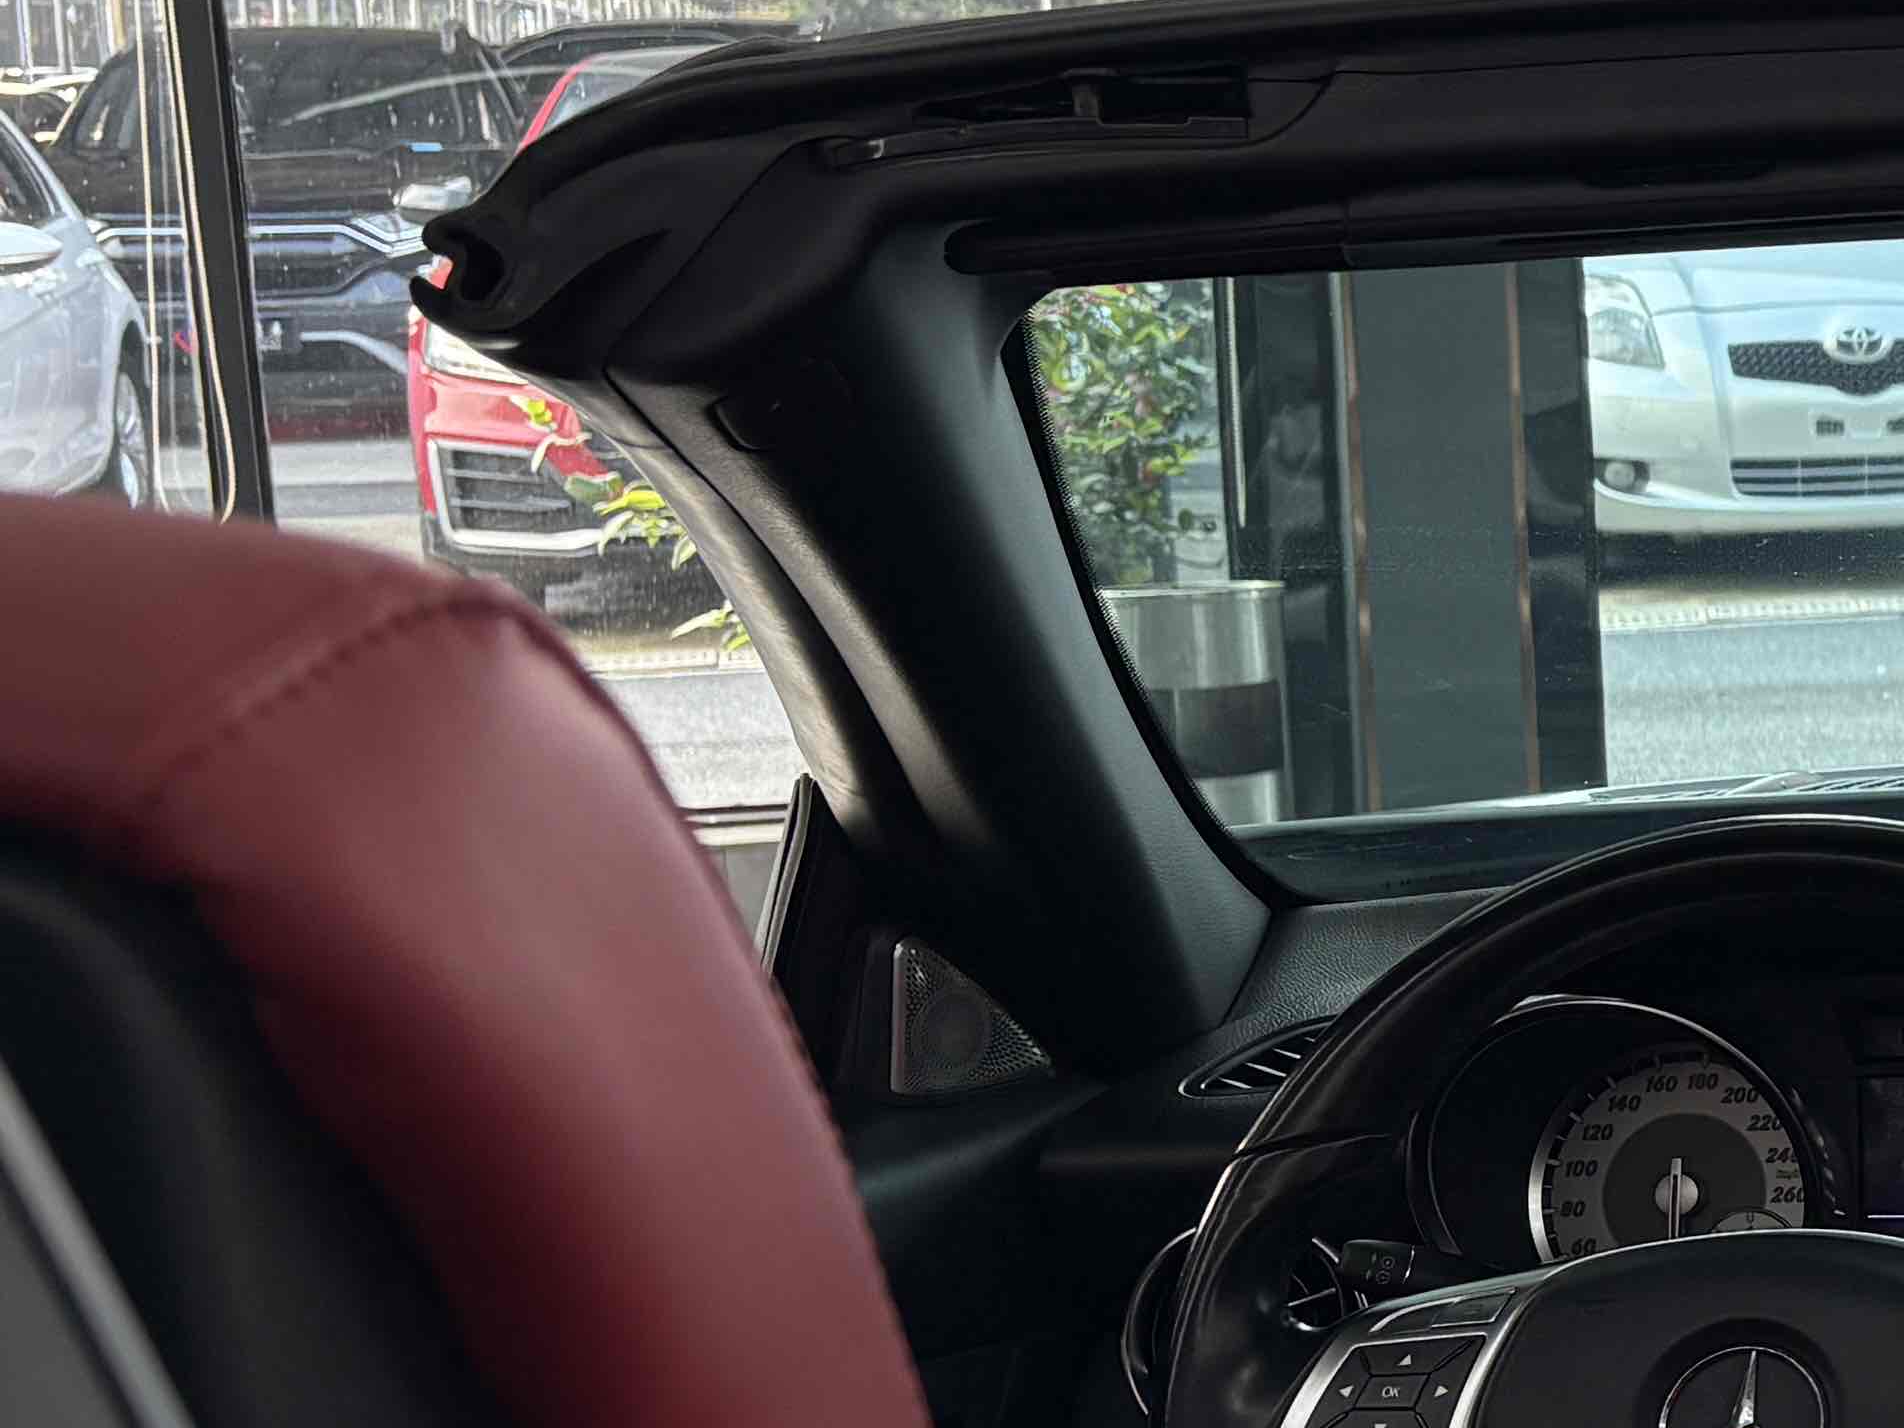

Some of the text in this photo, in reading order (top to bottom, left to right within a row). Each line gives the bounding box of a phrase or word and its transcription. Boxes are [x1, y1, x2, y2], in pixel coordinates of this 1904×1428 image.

[1646, 1076, 1678, 1093] 160
[1721, 1087, 1759, 1104] 200
[1607, 1096, 1641, 1113] 140
[1582, 1124, 1613, 1141] 120
[1565, 1160, 1598, 1177] 100
[1771, 1187, 1805, 1203] 260
